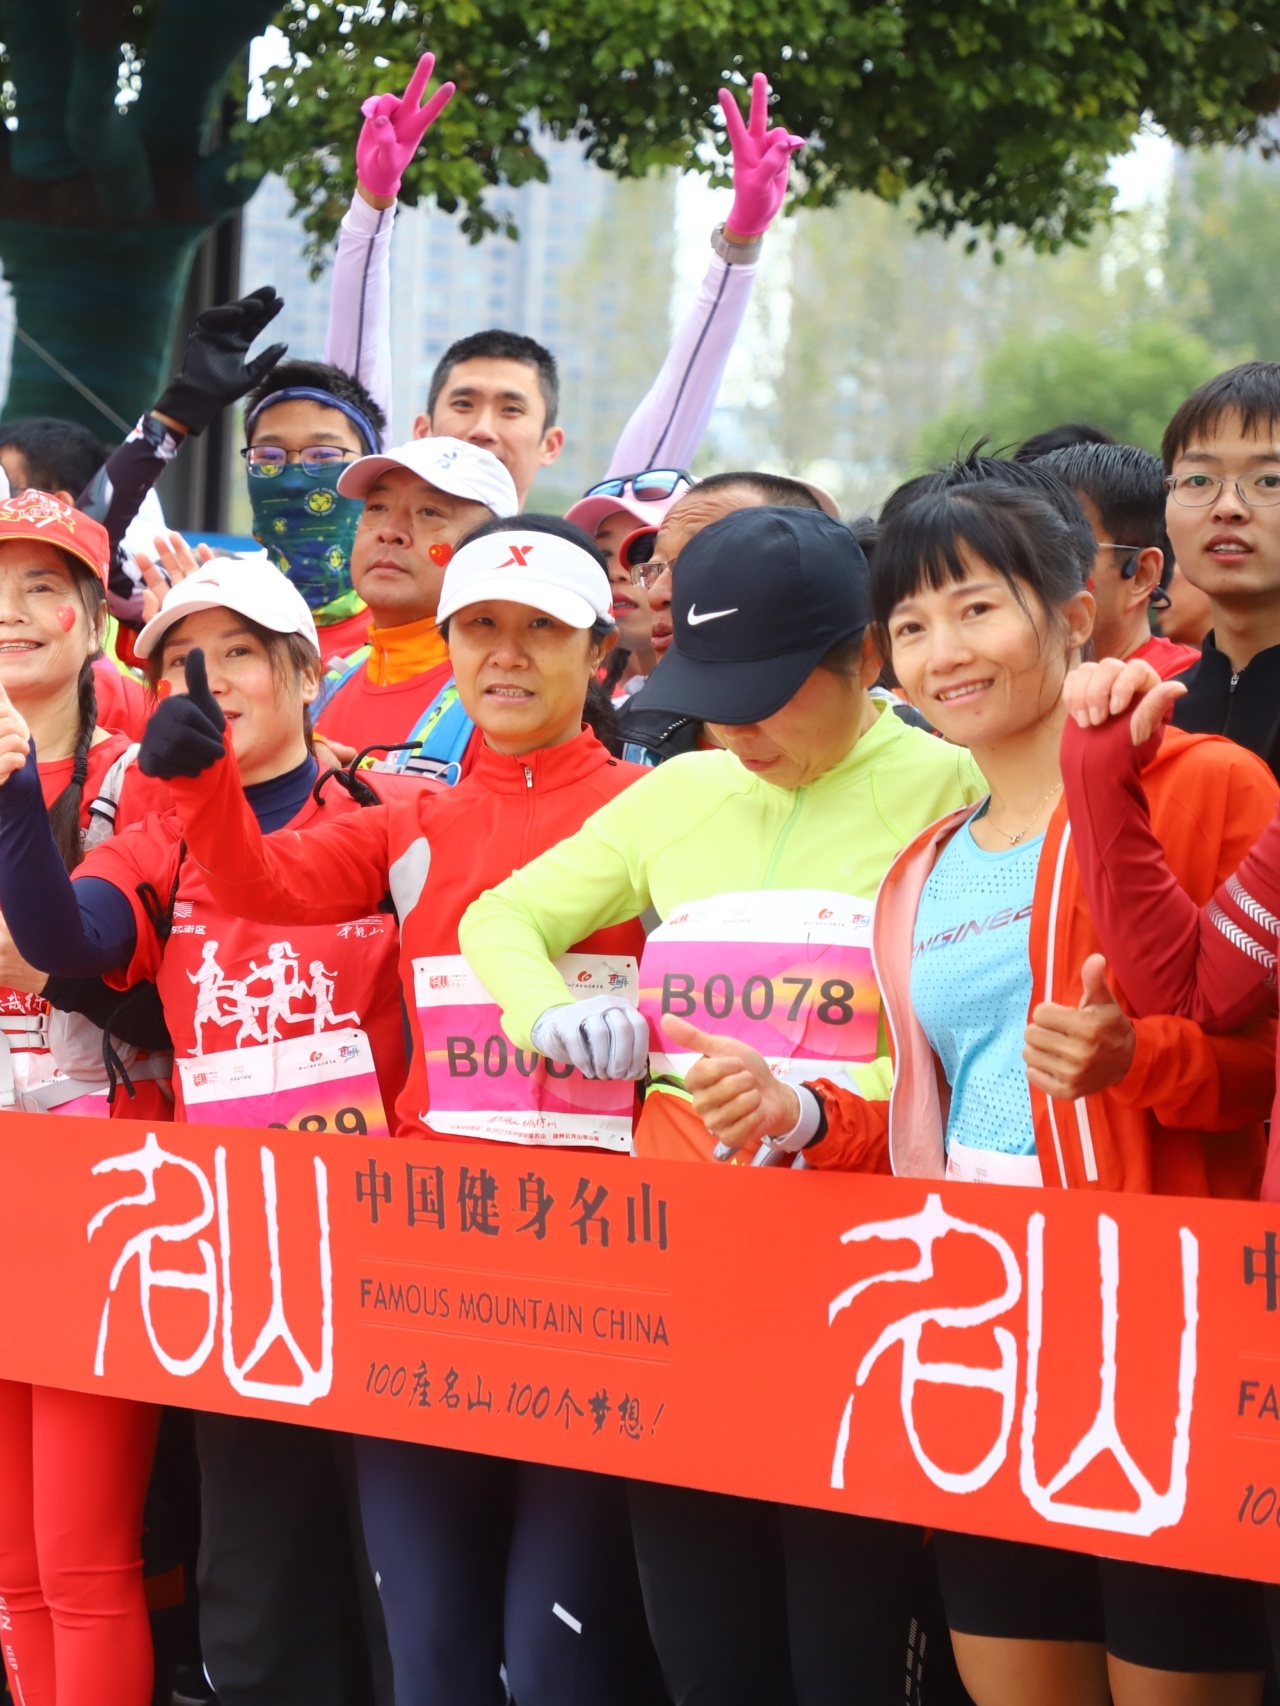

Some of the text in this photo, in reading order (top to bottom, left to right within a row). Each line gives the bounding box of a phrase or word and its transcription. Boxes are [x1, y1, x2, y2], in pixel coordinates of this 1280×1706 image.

[18, 507, 62, 519] LOVE
[661, 973, 855, 1026] B0078
[446, 1034, 613, 1081] B00
[268, 1107, 368, 1137] 89
[354, 1158, 669, 1252] 中国健身名山
[359, 1278, 670, 1347] FAMOUS MOUNTAIN CHINA
